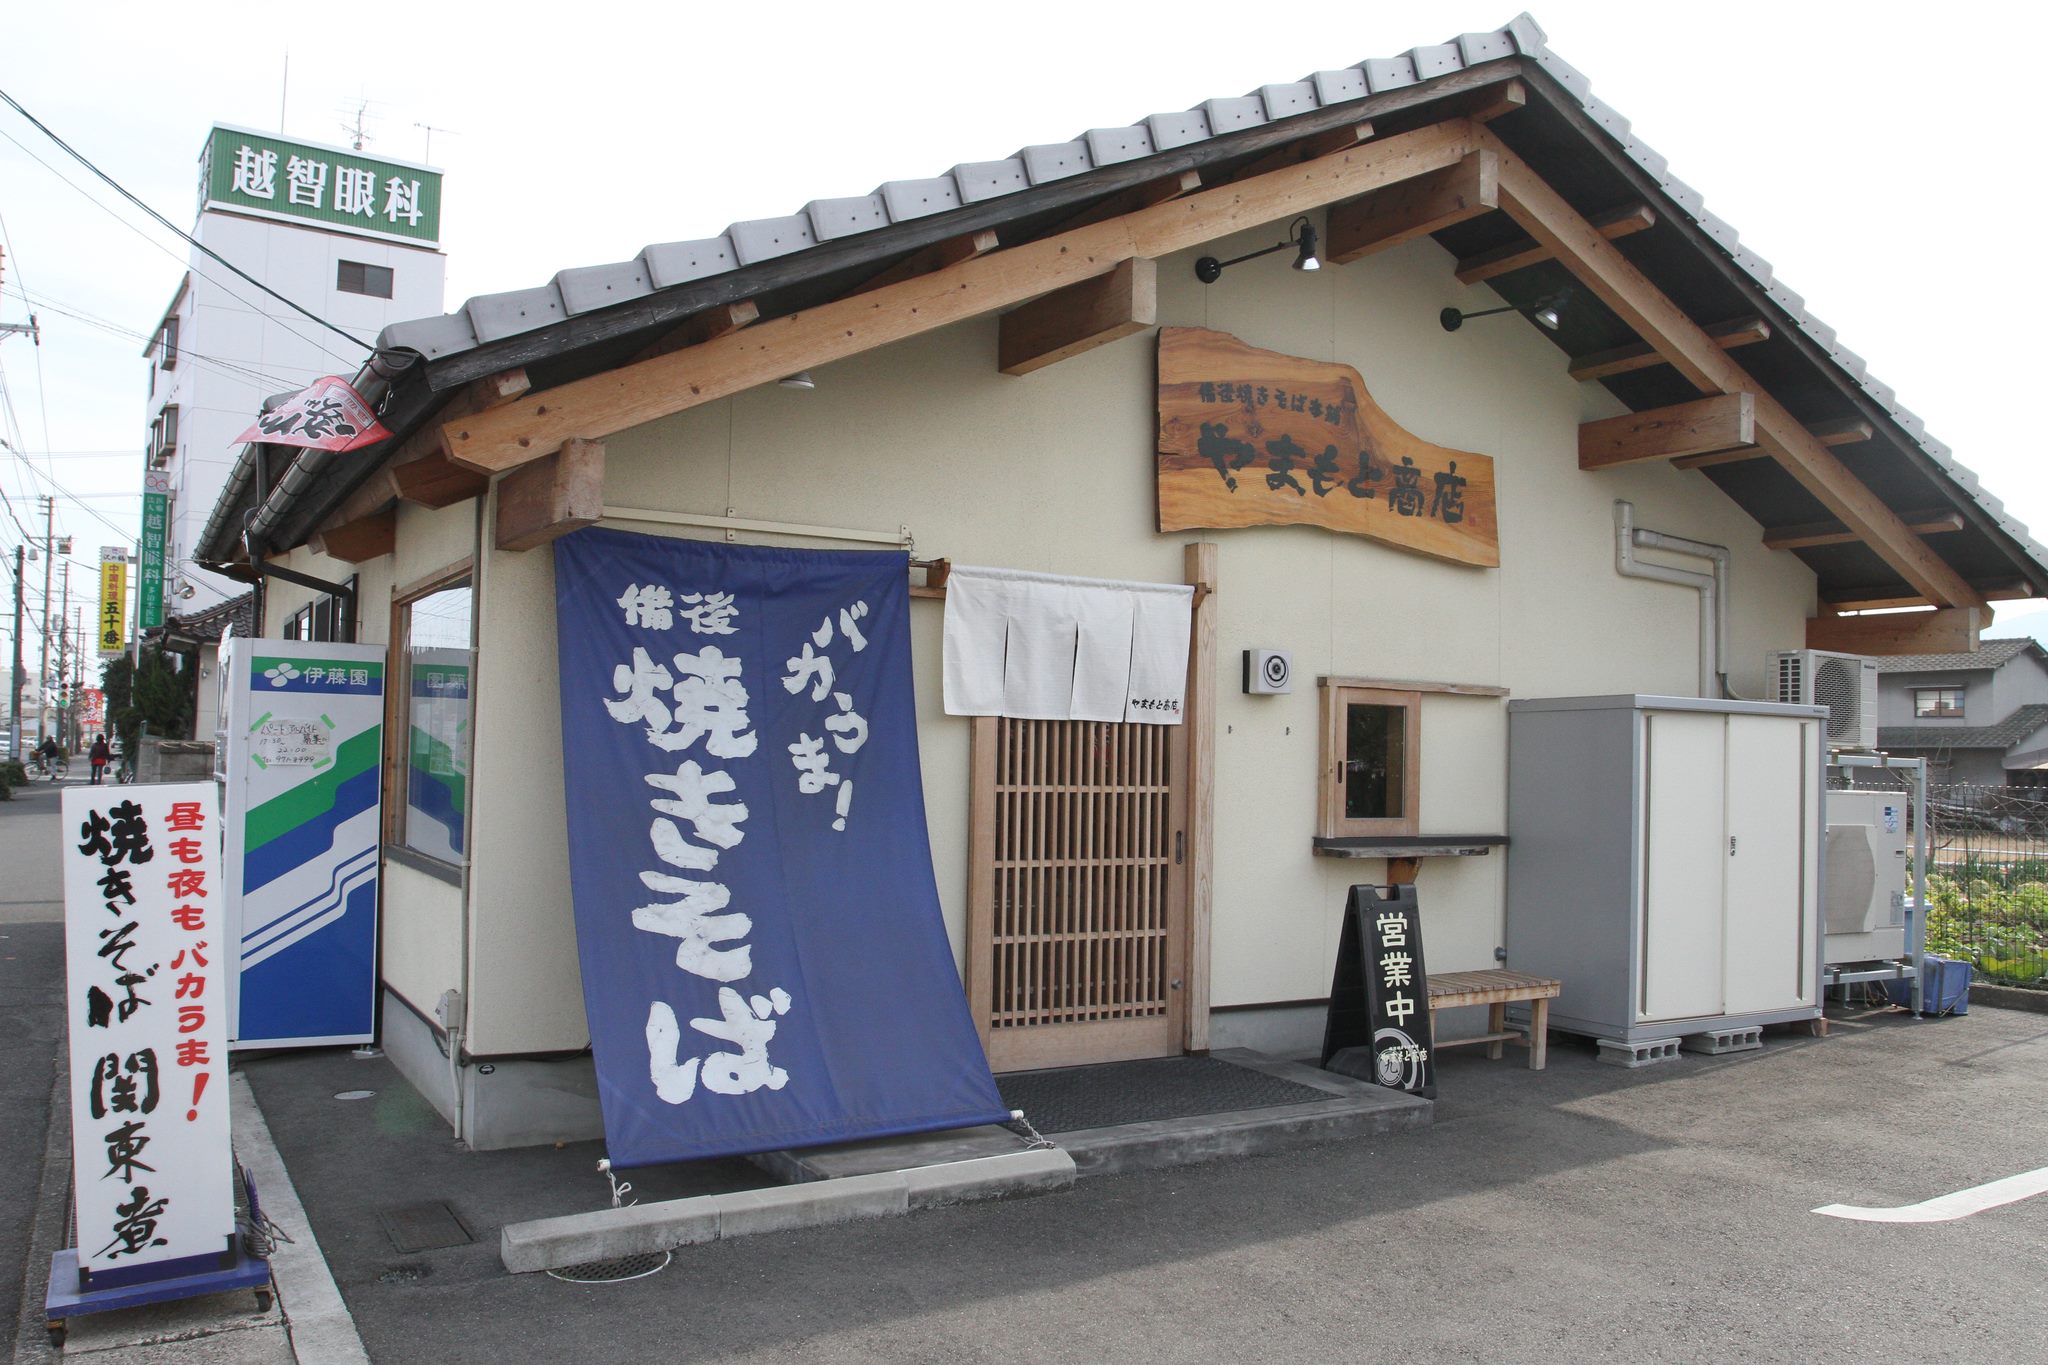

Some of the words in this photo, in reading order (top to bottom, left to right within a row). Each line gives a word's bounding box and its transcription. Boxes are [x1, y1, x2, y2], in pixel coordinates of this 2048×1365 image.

[231, 145, 424, 228] 越智眼科
[1197, 421, 1467, 524] やまもと商店
[144, 513, 163, 585] 越智眼科
[103, 601, 120, 645] 五十番
[616, 582, 741, 636] 備後
[303, 666, 368, 686] 伊藤園
[1131, 698, 1179, 711] やまもと商店
[164, 801, 208, 931] 昼も夜も
[602, 645, 793, 1106] 焼きそば
[77, 799, 160, 1029] 焼きそば
[1376, 911, 1415, 1027] 営業中
[90, 1047, 169, 1260] 関東煮
